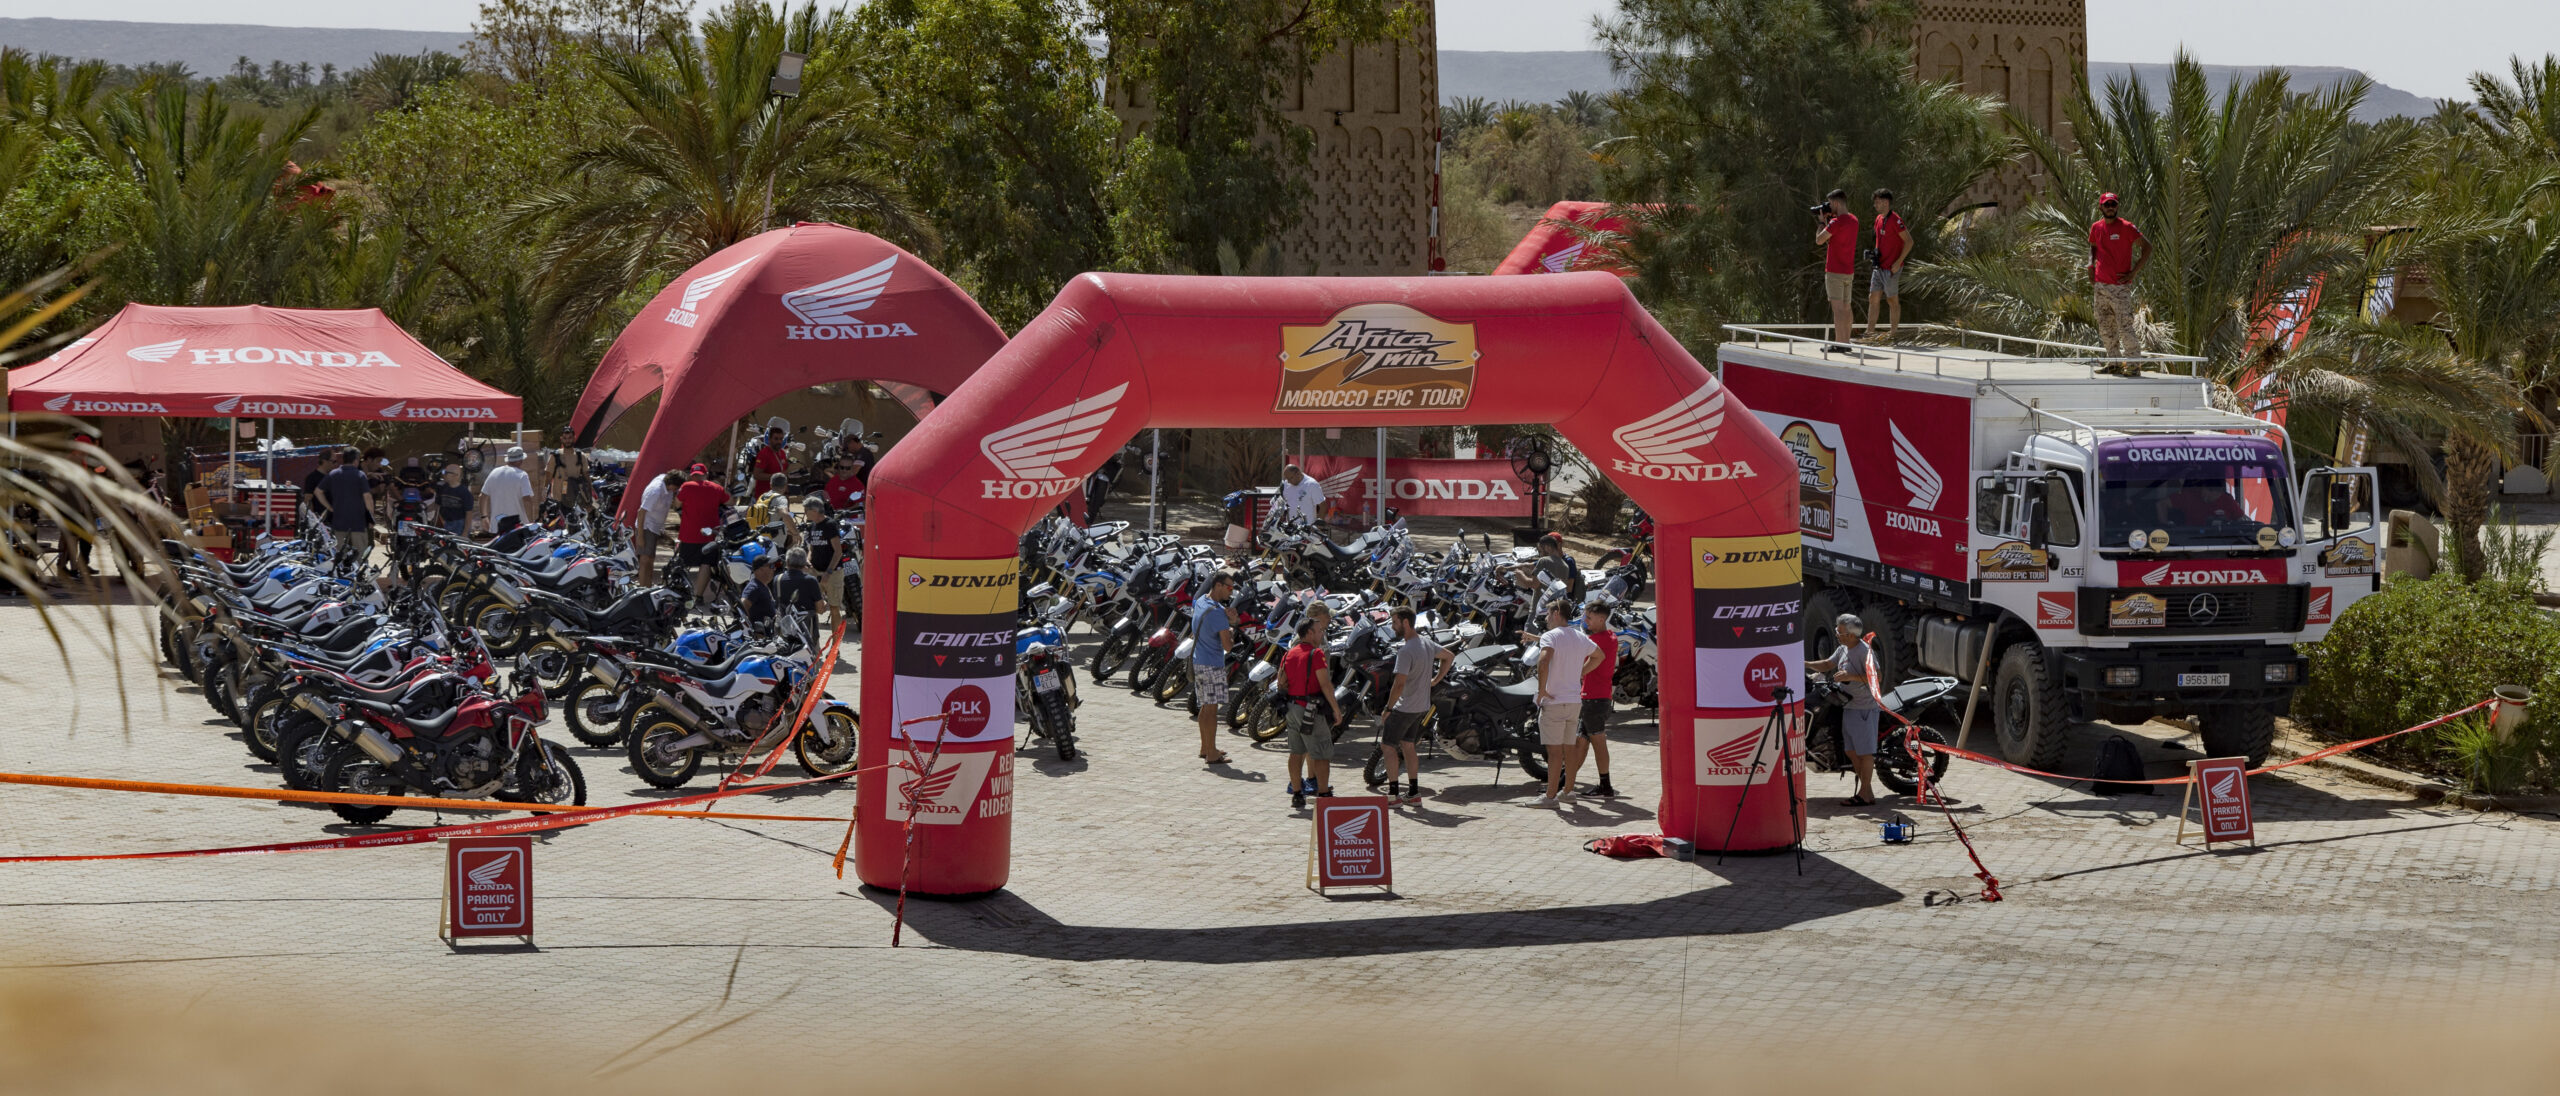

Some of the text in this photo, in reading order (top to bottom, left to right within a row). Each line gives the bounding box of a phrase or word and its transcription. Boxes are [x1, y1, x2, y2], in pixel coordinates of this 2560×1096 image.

[664, 308, 699, 328] HONDA
[785, 322, 918, 340] HONDA
[1298, 320, 1457, 361] Africa
[189, 347, 401, 369] HONDA
[1337, 349, 1465, 387] Twin
[1282, 388, 1465, 408] MOROCCO EPIC TOUR
[72, 400, 168, 413] HONDA
[241, 402, 336, 416] HONDA
[405, 407, 498, 419] HONDA
[1796, 432, 1810, 448] 2022
[2128, 445, 2257, 462] ORGANIZACIÓN
[1612, 458, 1757, 482] HONDA
[1800, 467, 1829, 488] win
[1362, 478, 1519, 500] HONDA
[1800, 505, 1811, 525] PIC
[1813, 507, 1830, 530] TOUR
[1885, 510, 1942, 537] HONDA
[1722, 547, 1799, 563] DUNLOP
[928, 573, 1016, 588] DUNLOP
[1981, 572, 2045, 580] MOROCCO EPIC TOUR
[2171, 570, 2267, 585] HONDA
[1713, 600, 1800, 619] DAINESE
[1755, 625, 1780, 633] TCX
[913, 630, 1014, 647] DAINESE
[1751, 667, 1779, 681] PLK
[2185, 675, 2228, 685] 9563 HCT
[951, 701, 981, 715] PLK
[2213, 806, 2241, 816] PARKING
[496, 820, 539, 830] Montesa
[2220, 821, 2237, 830] ONLY
[428, 828, 471, 838] Montesa
[359, 836, 404, 846] Montesa
[1334, 838, 1374, 846] HONDA
[1333, 848, 1375, 858] PARKING
[1342, 865, 1367, 874] ONLY
[468, 883, 514, 891] HONDA
[467, 894, 515, 904] PARKING
[477, 912, 505, 922] ONLY
